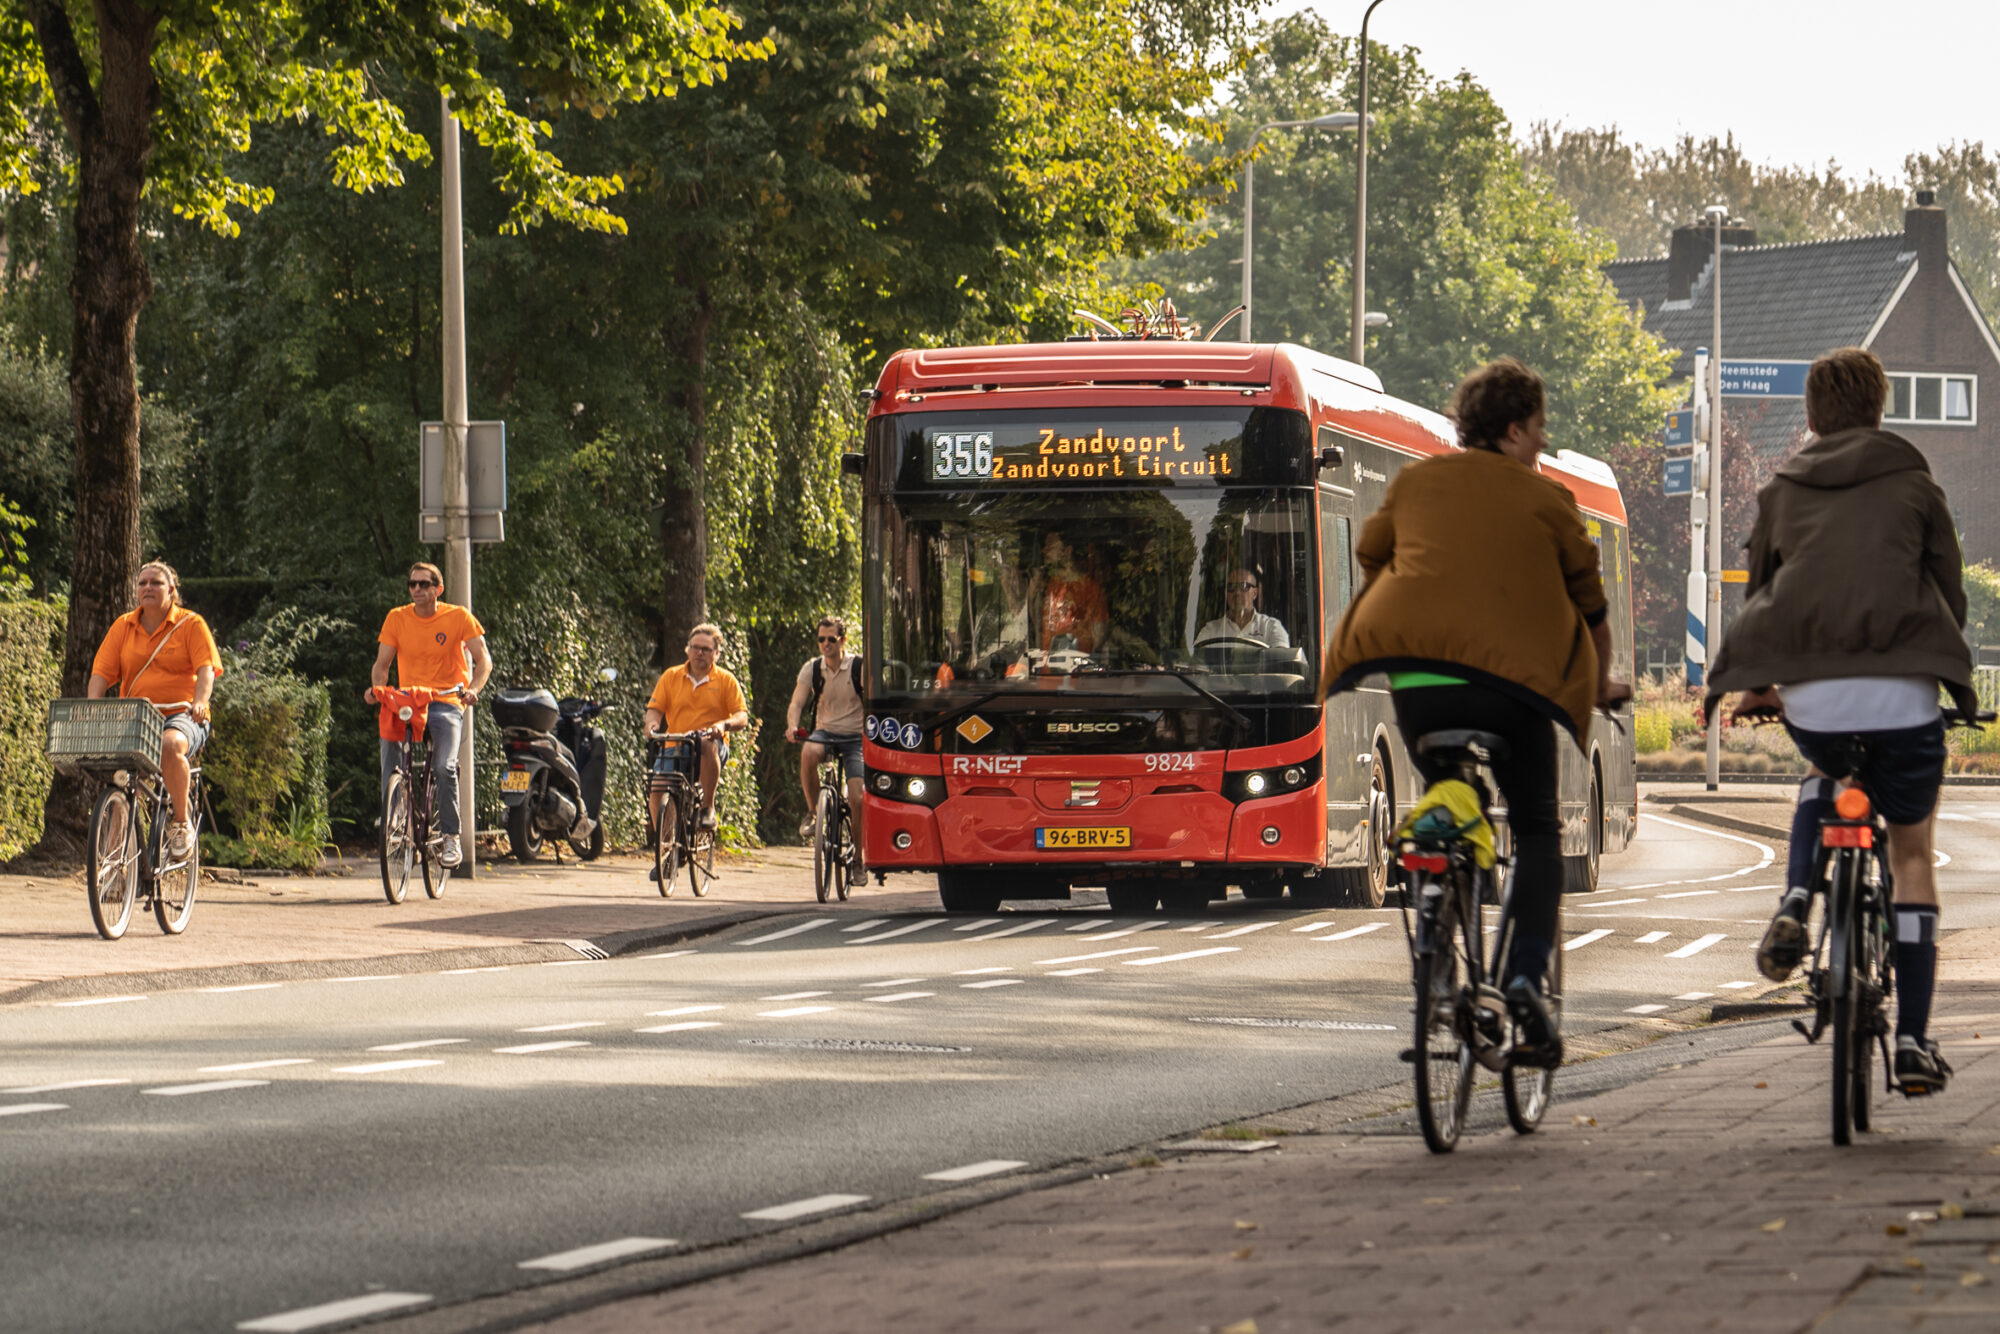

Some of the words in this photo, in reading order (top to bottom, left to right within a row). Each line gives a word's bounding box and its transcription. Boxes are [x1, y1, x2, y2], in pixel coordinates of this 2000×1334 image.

[1720, 365, 1778, 376] Heemstede
[1720, 380, 1740, 390] Den
[1743, 380, 1770, 393] Haag
[1039, 426, 1186, 455] Zandvoort
[935, 433, 992, 477] 356
[992, 454, 1124, 479] Zandvoort
[1137, 452, 1232, 476] Circuit
[1047, 722, 1120, 733] EBUSCO
[1144, 753, 1195, 772] 9824
[1050, 829, 1126, 845] 96-BRV-5
